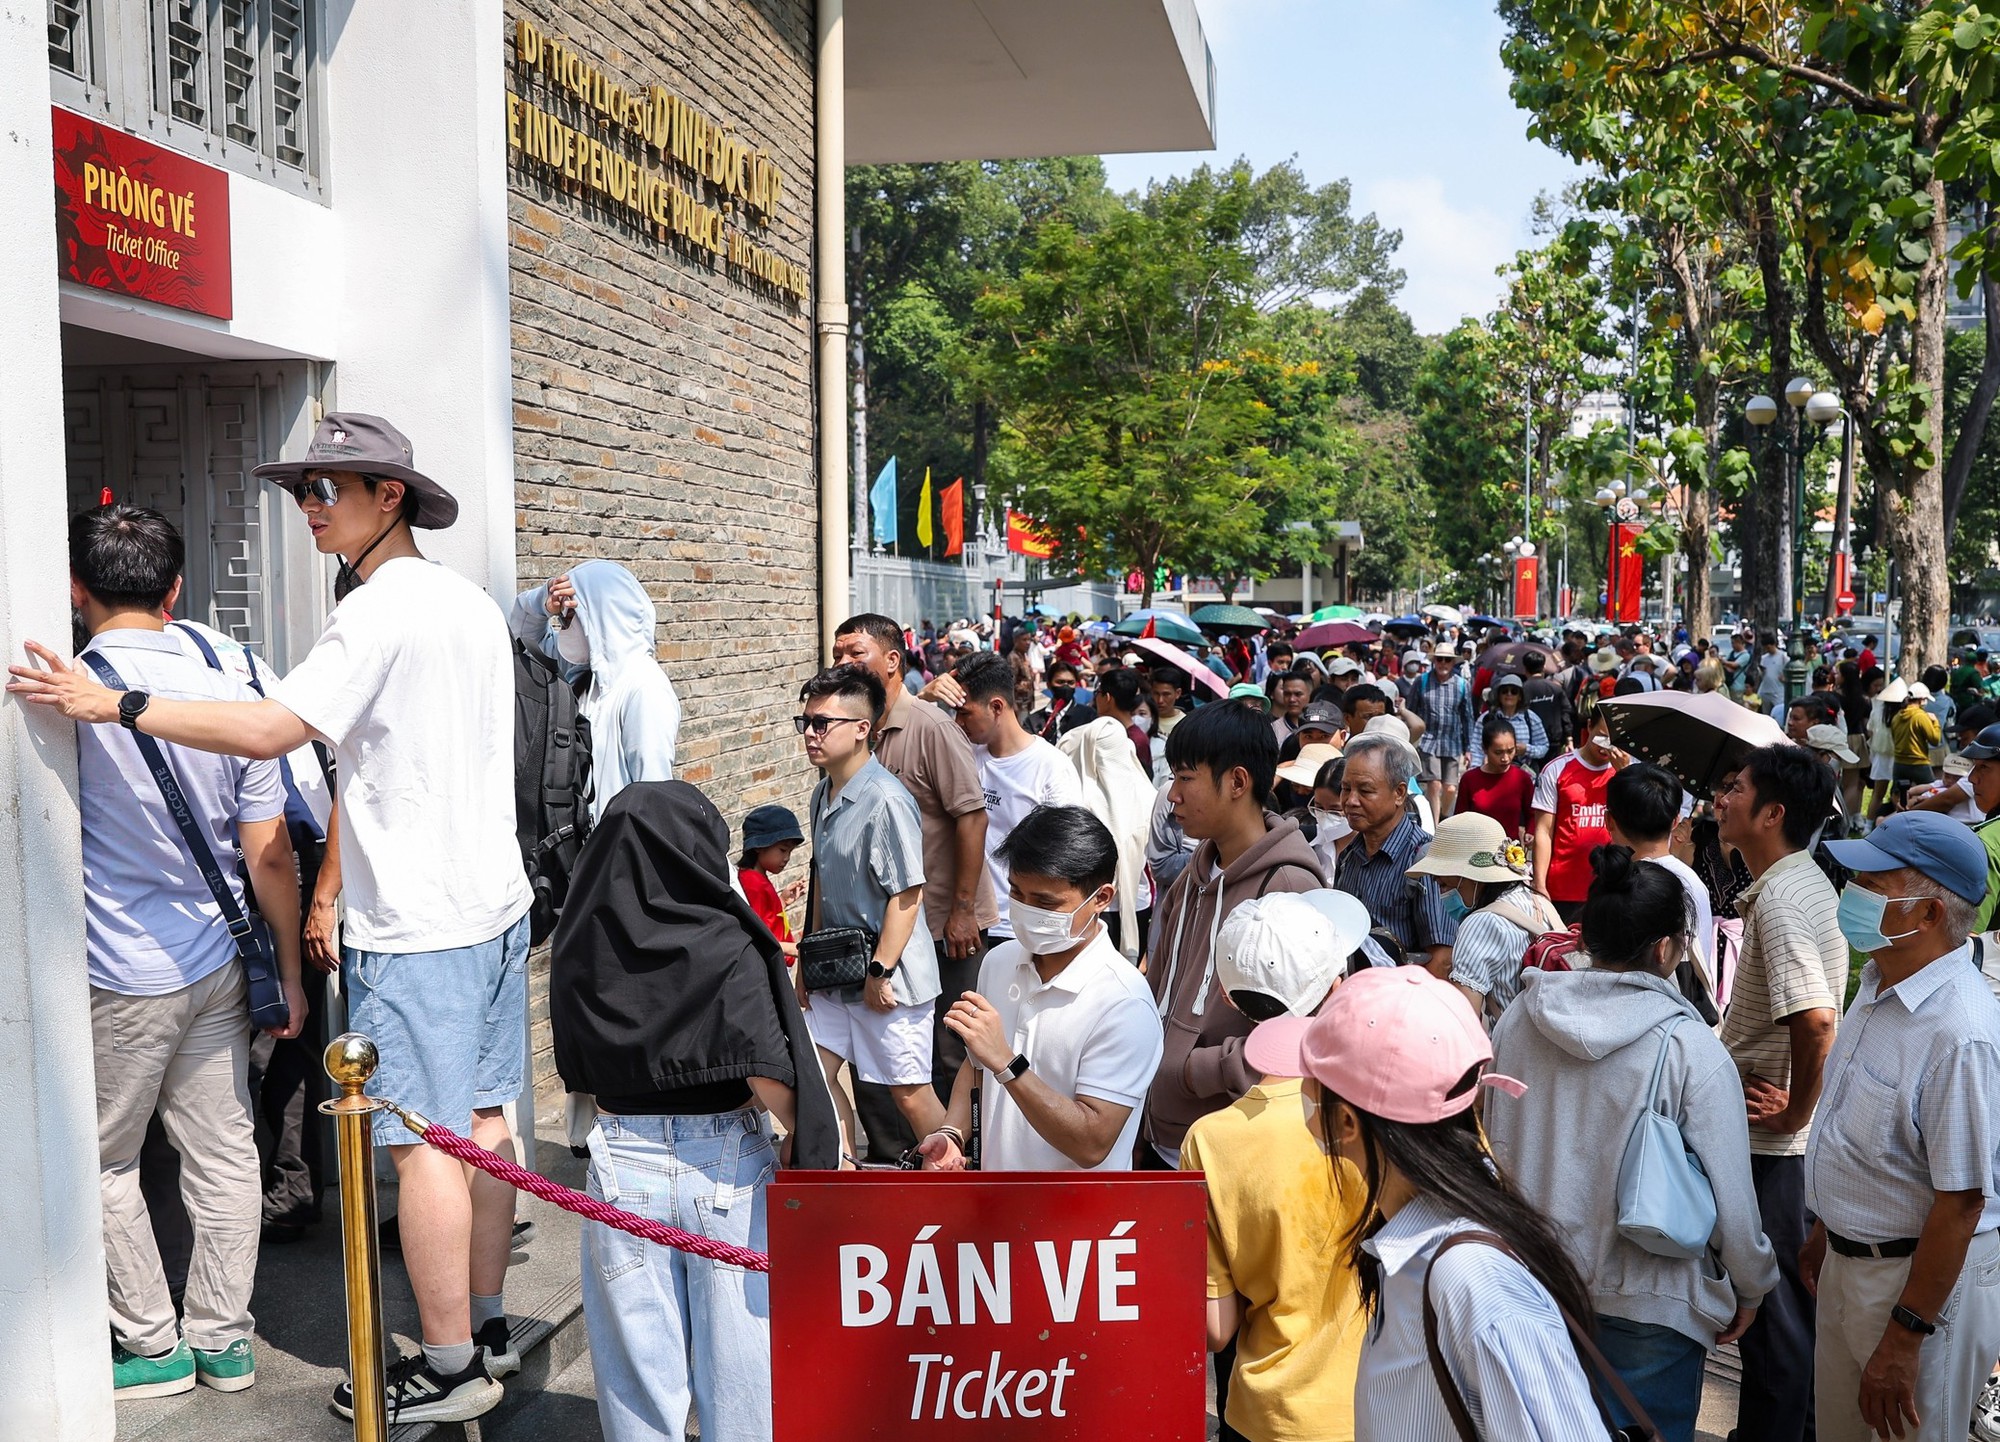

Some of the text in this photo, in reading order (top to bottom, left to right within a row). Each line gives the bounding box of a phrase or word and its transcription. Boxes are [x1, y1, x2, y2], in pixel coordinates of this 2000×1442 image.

[520, 20, 544, 73] DI
[654, 85, 707, 176] DINH
[84, 162, 196, 238] PHÒNG VÉ
[507, 91, 521, 148] E
[526, 102, 668, 227] INDEPENDENCE
[673, 187, 725, 256] PALACE
[735, 233, 790, 289] HISTORICAL
[106, 223, 180, 270] Ticket Office
[155, 767, 192, 827] LACOSTE
[1591, 816, 1605, 828] BET
[207, 869, 223, 893] STE
[838, 1220, 1140, 1327] BÁN VÉ
[907, 1351, 1075, 1420] Ticket
